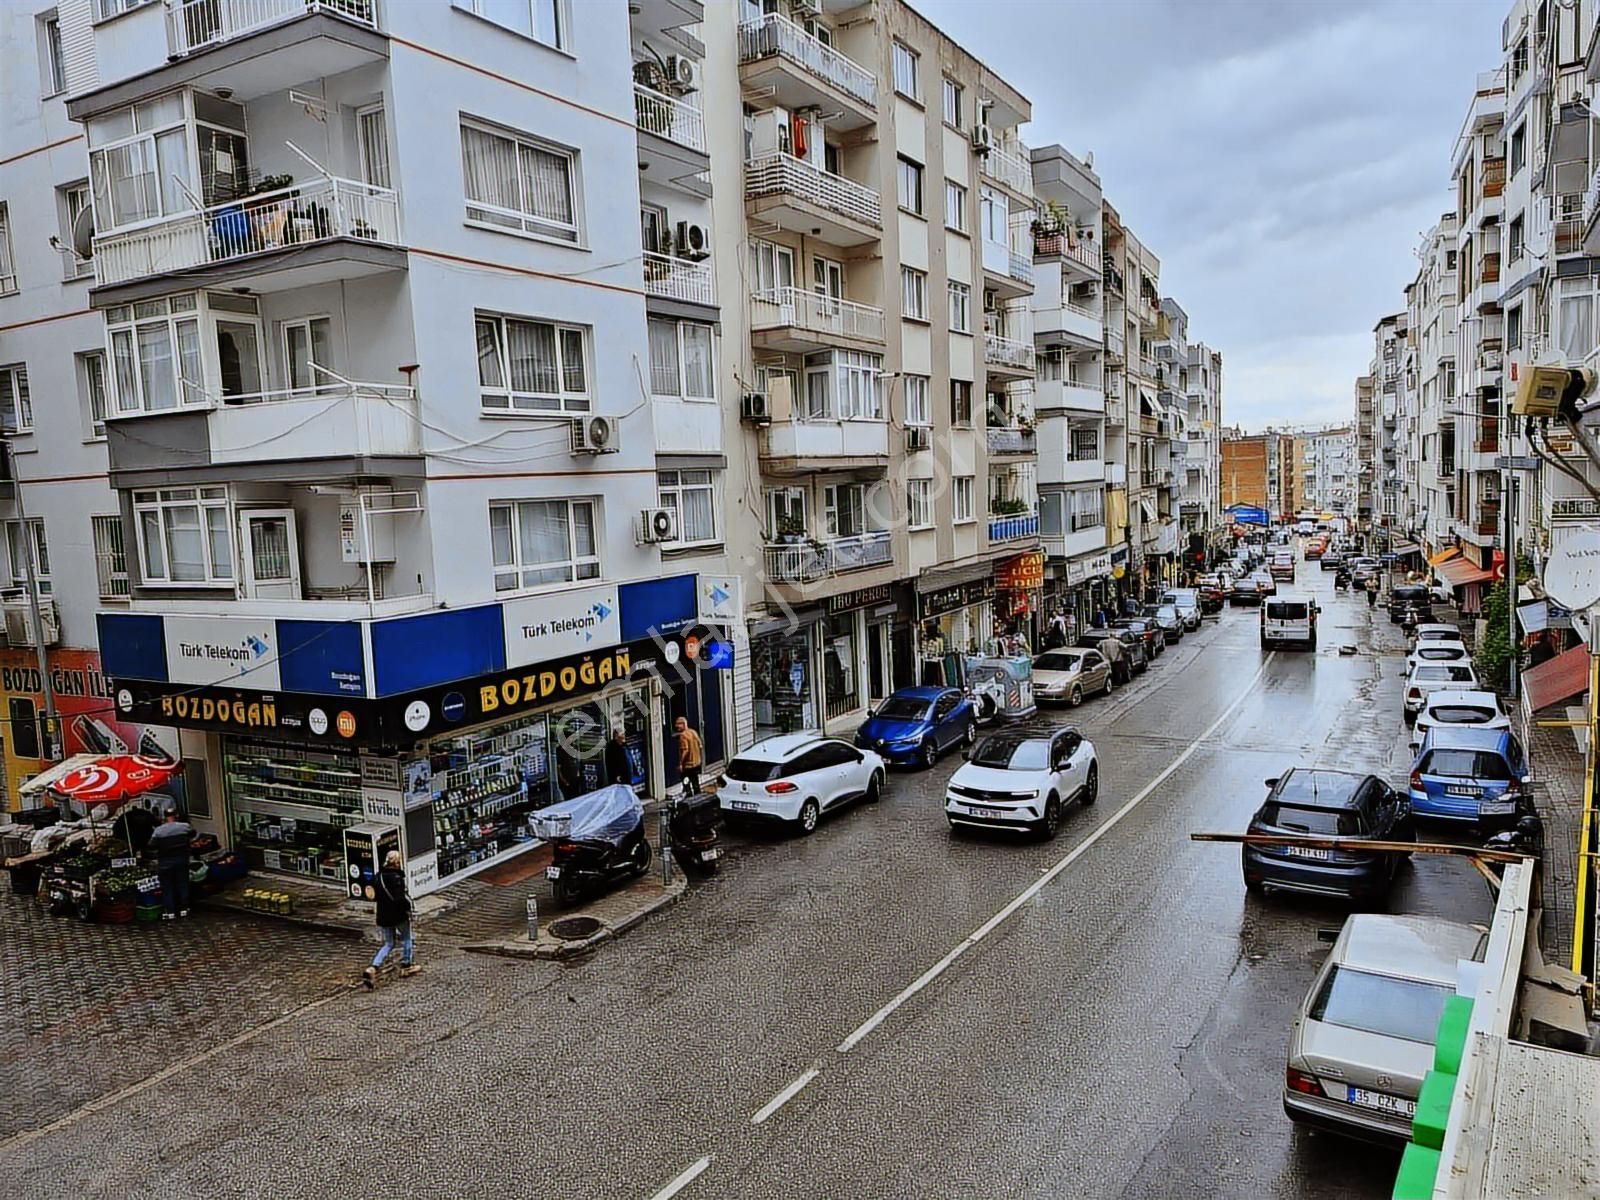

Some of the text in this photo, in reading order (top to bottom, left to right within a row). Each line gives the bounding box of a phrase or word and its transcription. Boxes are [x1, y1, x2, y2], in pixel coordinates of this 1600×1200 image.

[522, 616, 595, 639] Türk Telekom
[180, 643, 250, 660] Türk Telekom
[2, 663, 86, 696] BOZDĞAN
[479, 653, 631, 713] BOZDOĞAN
[161, 692, 278, 728] BOZDOĞAN
[367, 801, 400, 817] tivibu
[1356, 1089, 1370, 1103] 35
[1377, 1094, 1400, 1110] CZK
